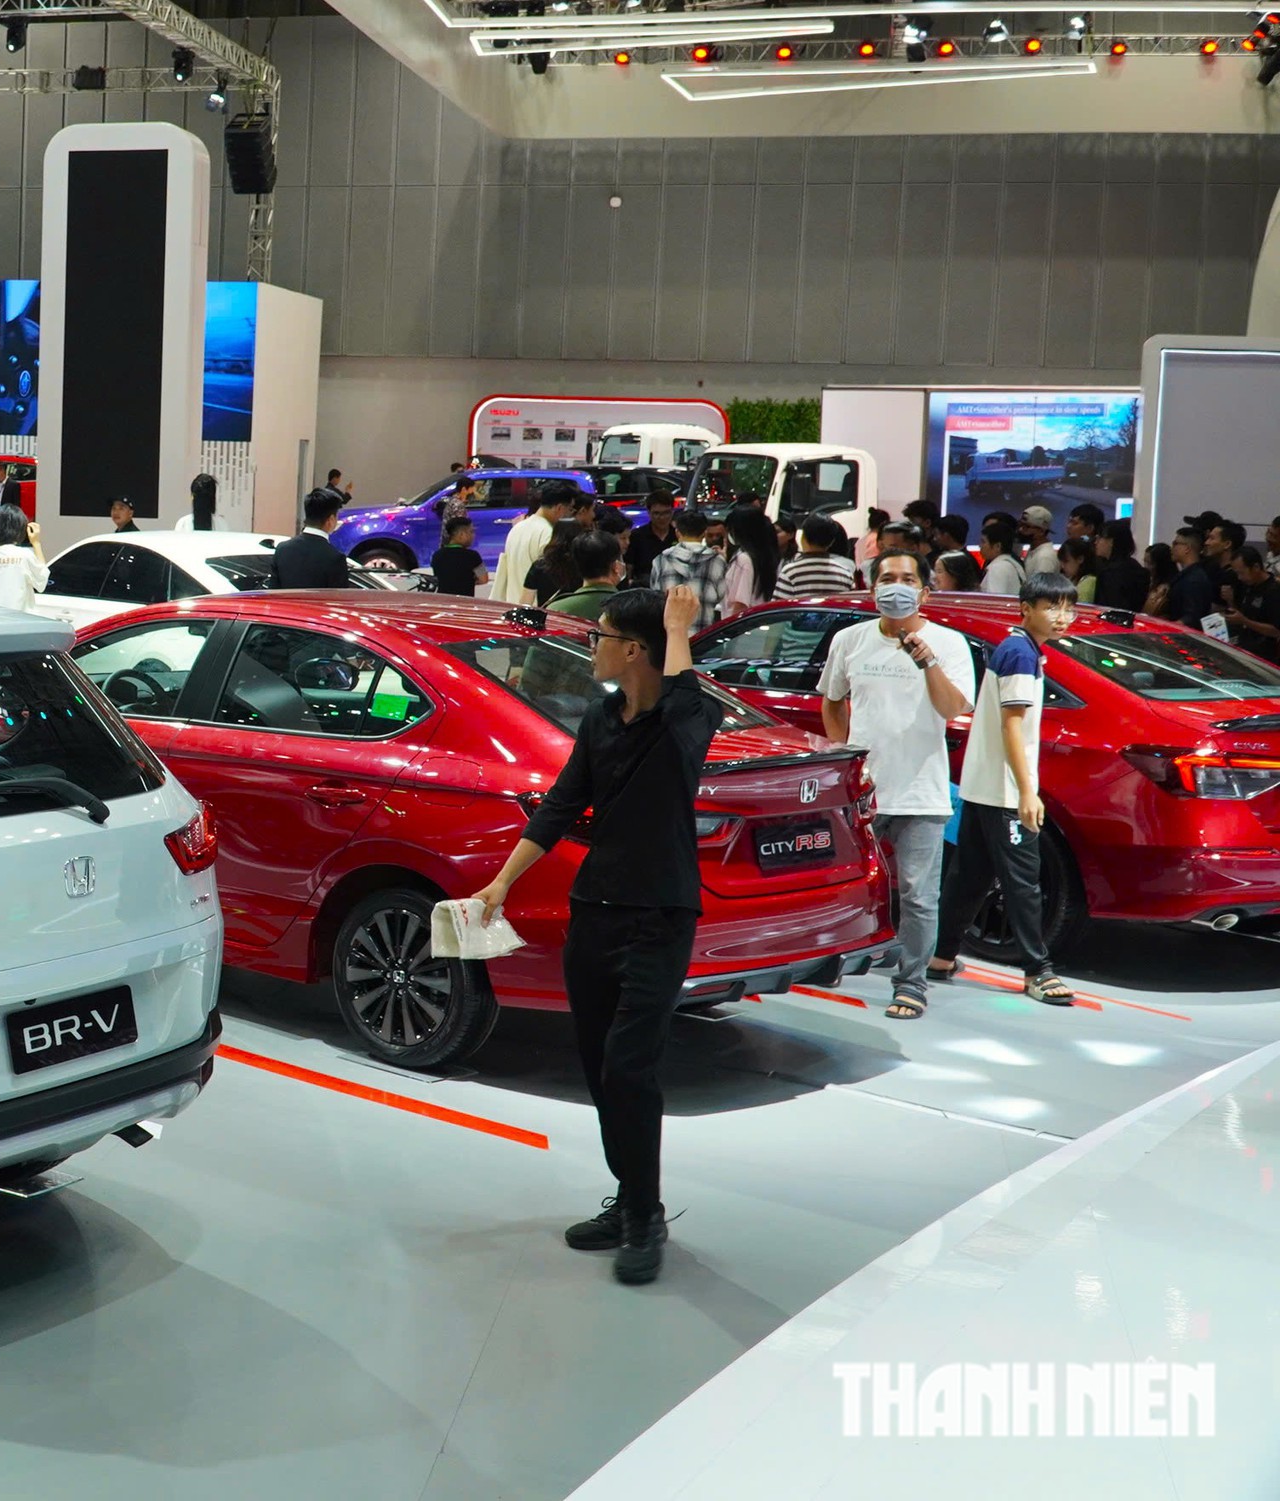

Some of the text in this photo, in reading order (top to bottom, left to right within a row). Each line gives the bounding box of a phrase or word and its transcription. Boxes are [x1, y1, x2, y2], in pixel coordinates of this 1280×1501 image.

[760, 831, 831, 856] CITY RS
[22, 1003, 120, 1055] BR-V
